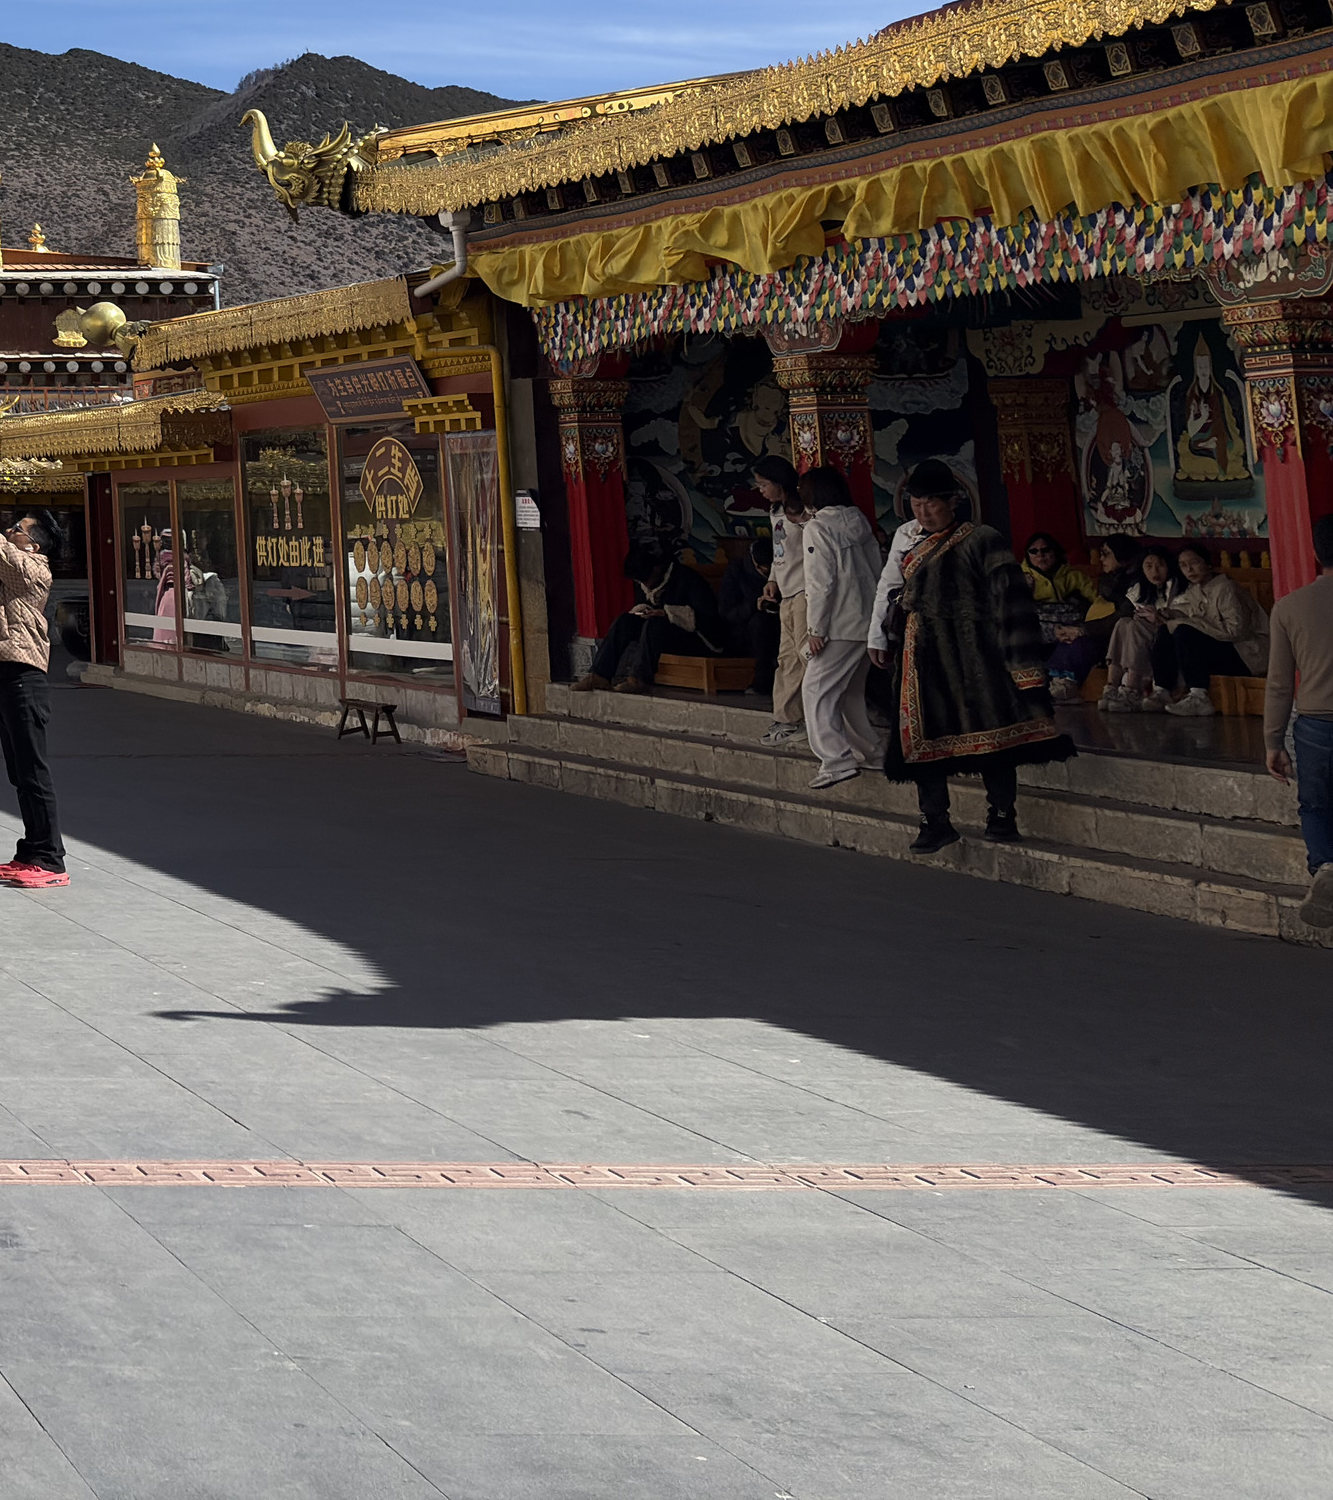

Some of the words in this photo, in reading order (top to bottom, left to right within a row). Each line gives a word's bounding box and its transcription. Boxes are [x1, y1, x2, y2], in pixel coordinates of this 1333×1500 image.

[365, 445, 419, 500] 十二生肖
[375, 494, 410, 519] 供灯处
[256, 535, 325, 567] 供灯处由此进
